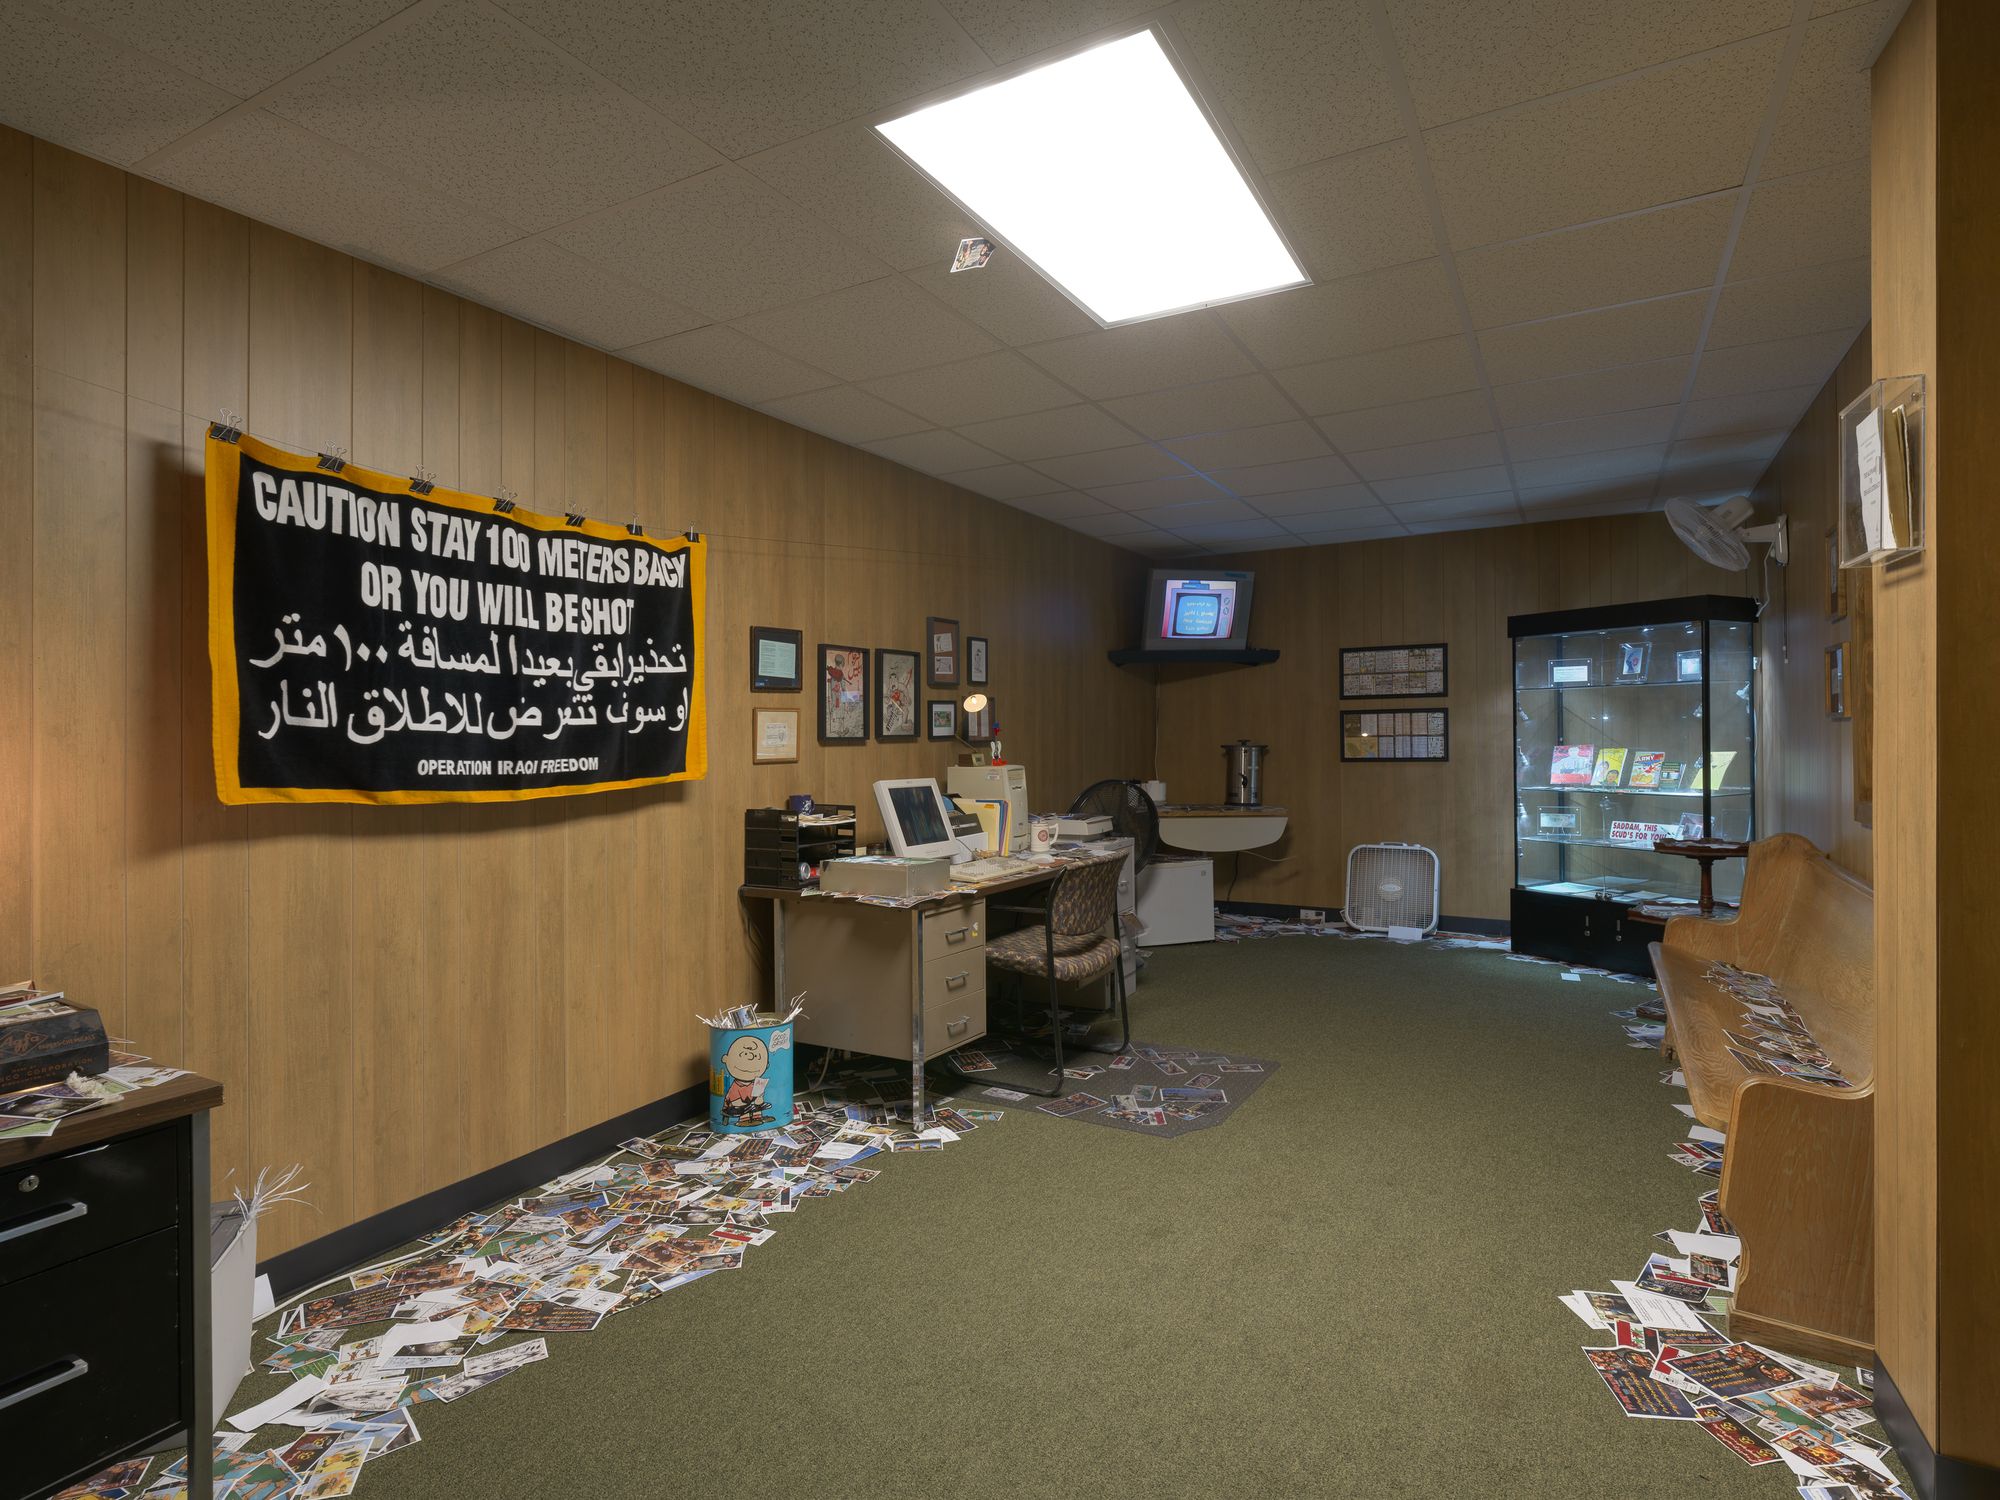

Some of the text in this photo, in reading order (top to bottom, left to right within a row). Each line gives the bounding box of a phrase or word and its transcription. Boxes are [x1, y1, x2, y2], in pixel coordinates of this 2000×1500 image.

[252, 471, 401, 548] CAUTION
[410, 506, 482, 563] STAY
[485, 523, 531, 573] 100
[537, 537, 631, 584] METERS
[360, 560, 636, 636] OR YOU WILL BE SHOT
[248, 612, 327, 669] متر
[257, 679, 338, 740] النار
[417, 756, 599, 776] OPERATION IRAQI FREEDOM
[1611, 830, 1633, 839] SCUD'S
[1635, 832, 1648, 840] FOR
[1612, 822, 1658, 832] SADDAM, THIS
